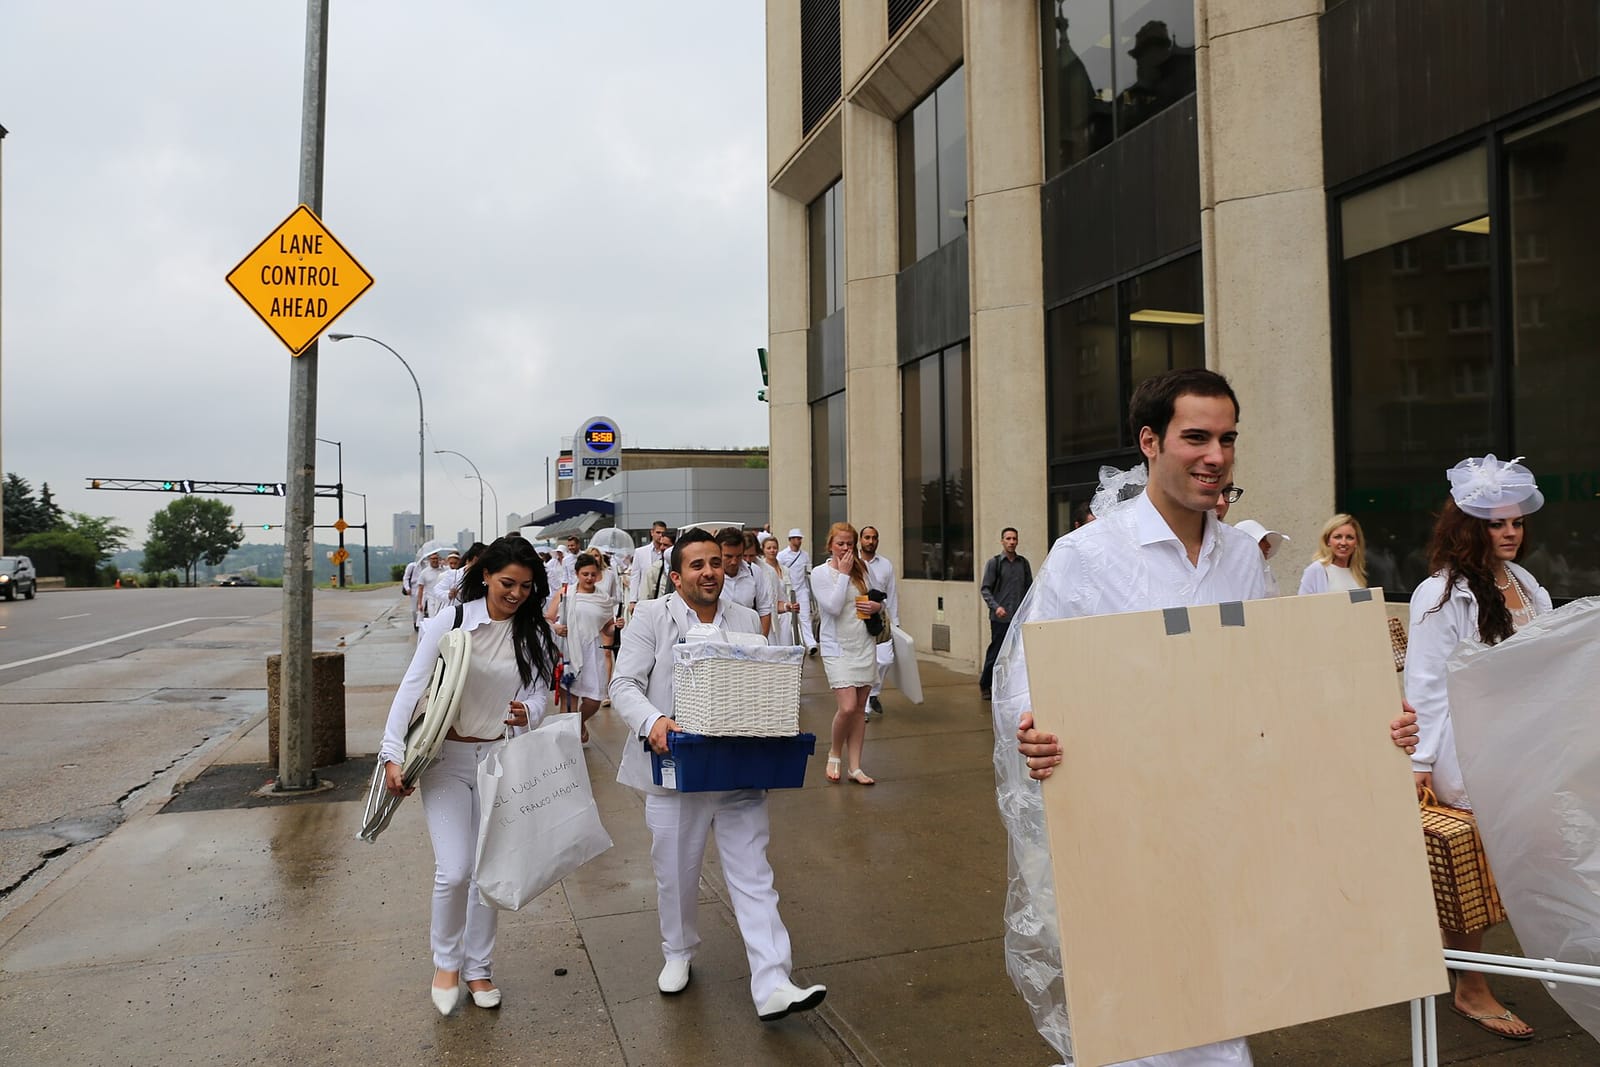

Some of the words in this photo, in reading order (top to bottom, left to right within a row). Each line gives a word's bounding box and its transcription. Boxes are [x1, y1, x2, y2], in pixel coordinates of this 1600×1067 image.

[280, 234, 323, 254] LANE
[261, 265, 339, 287] CONTROL
[270, 297, 328, 318] AHEAD
[591, 432, 613, 443] 5:58
[585, 466, 617, 481] ETS
